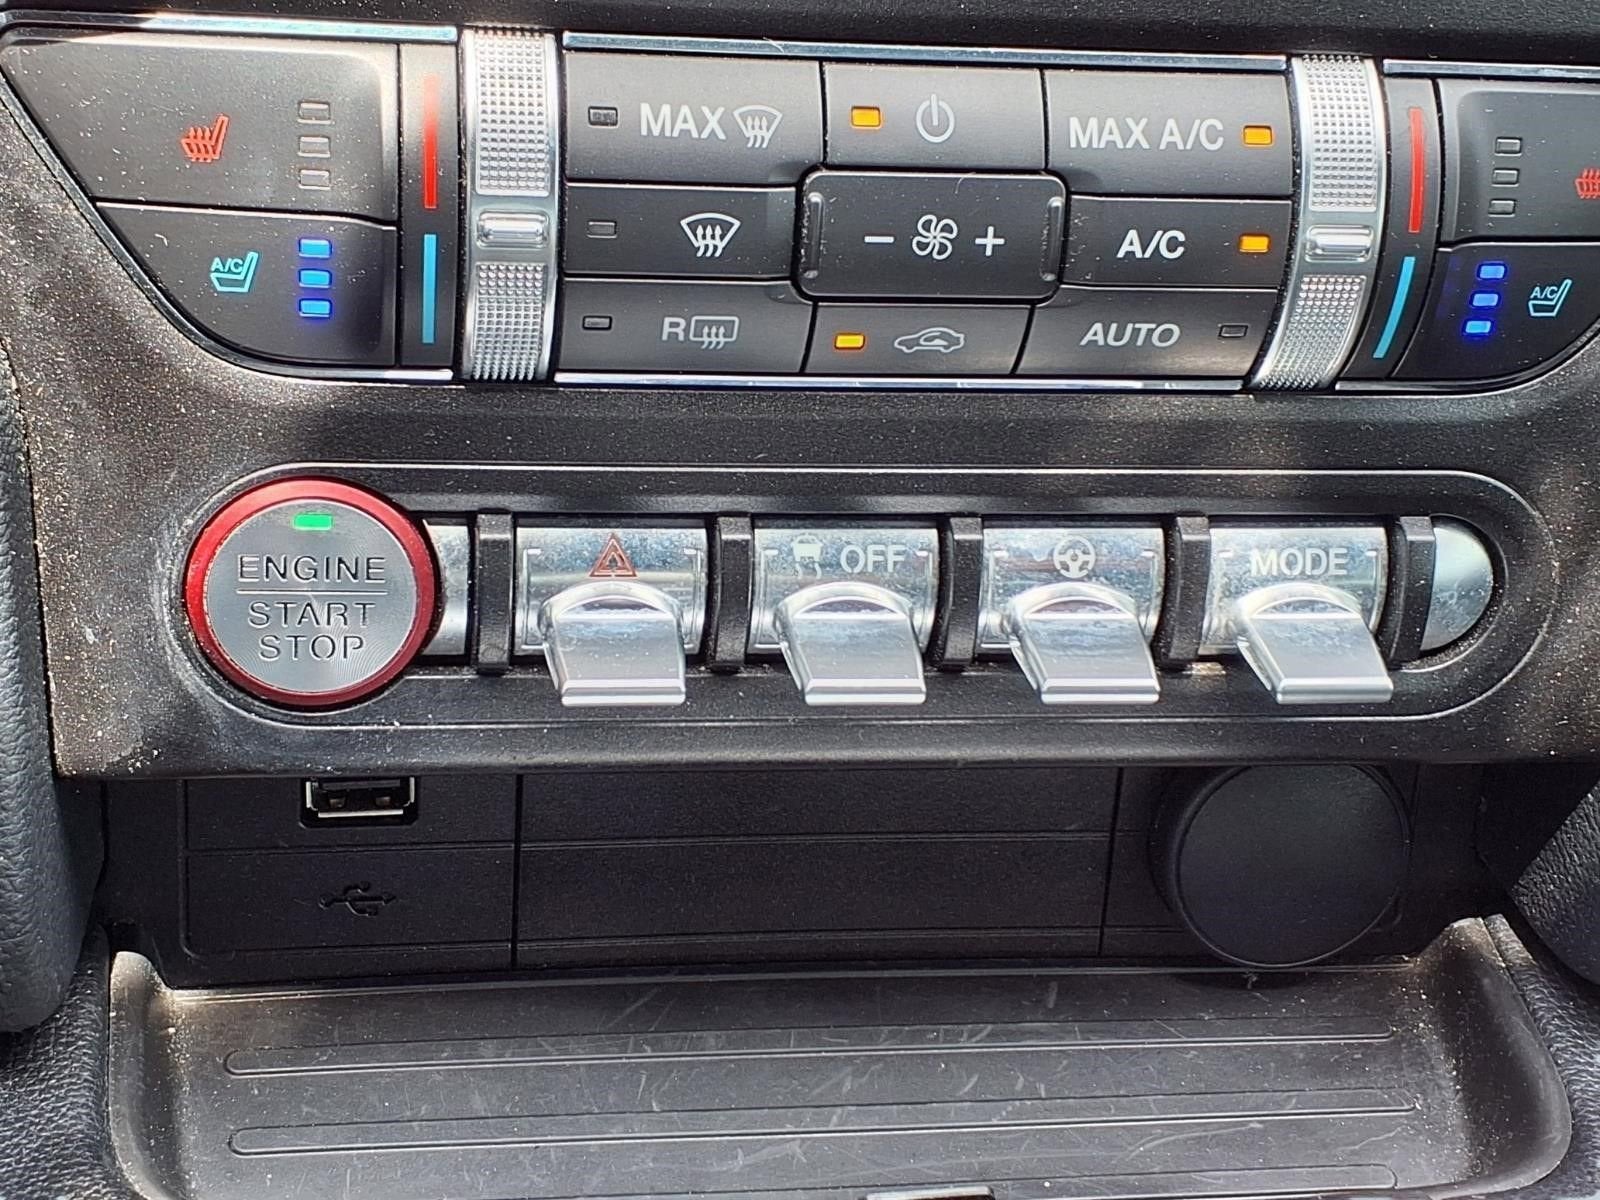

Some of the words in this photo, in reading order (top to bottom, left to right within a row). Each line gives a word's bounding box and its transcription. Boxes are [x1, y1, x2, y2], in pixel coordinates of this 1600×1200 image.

[640, 103, 726, 140] MAX
[1069, 117, 1151, 150] MAX
[1158, 118, 1224, 151] A/C
[1116, 230, 1187, 259] A/C
[211, 257, 243, 273] A/C
[1530, 286, 1557, 300] A/C
[661, 317, 685, 341] R
[1081, 322, 1181, 348] AUTO
[237, 554, 387, 584] ENGINE
[840, 545, 906, 575] OFF
[1250, 547, 1349, 576] MODE
[248, 602, 376, 628] START
[260, 634, 365, 662] STOP
